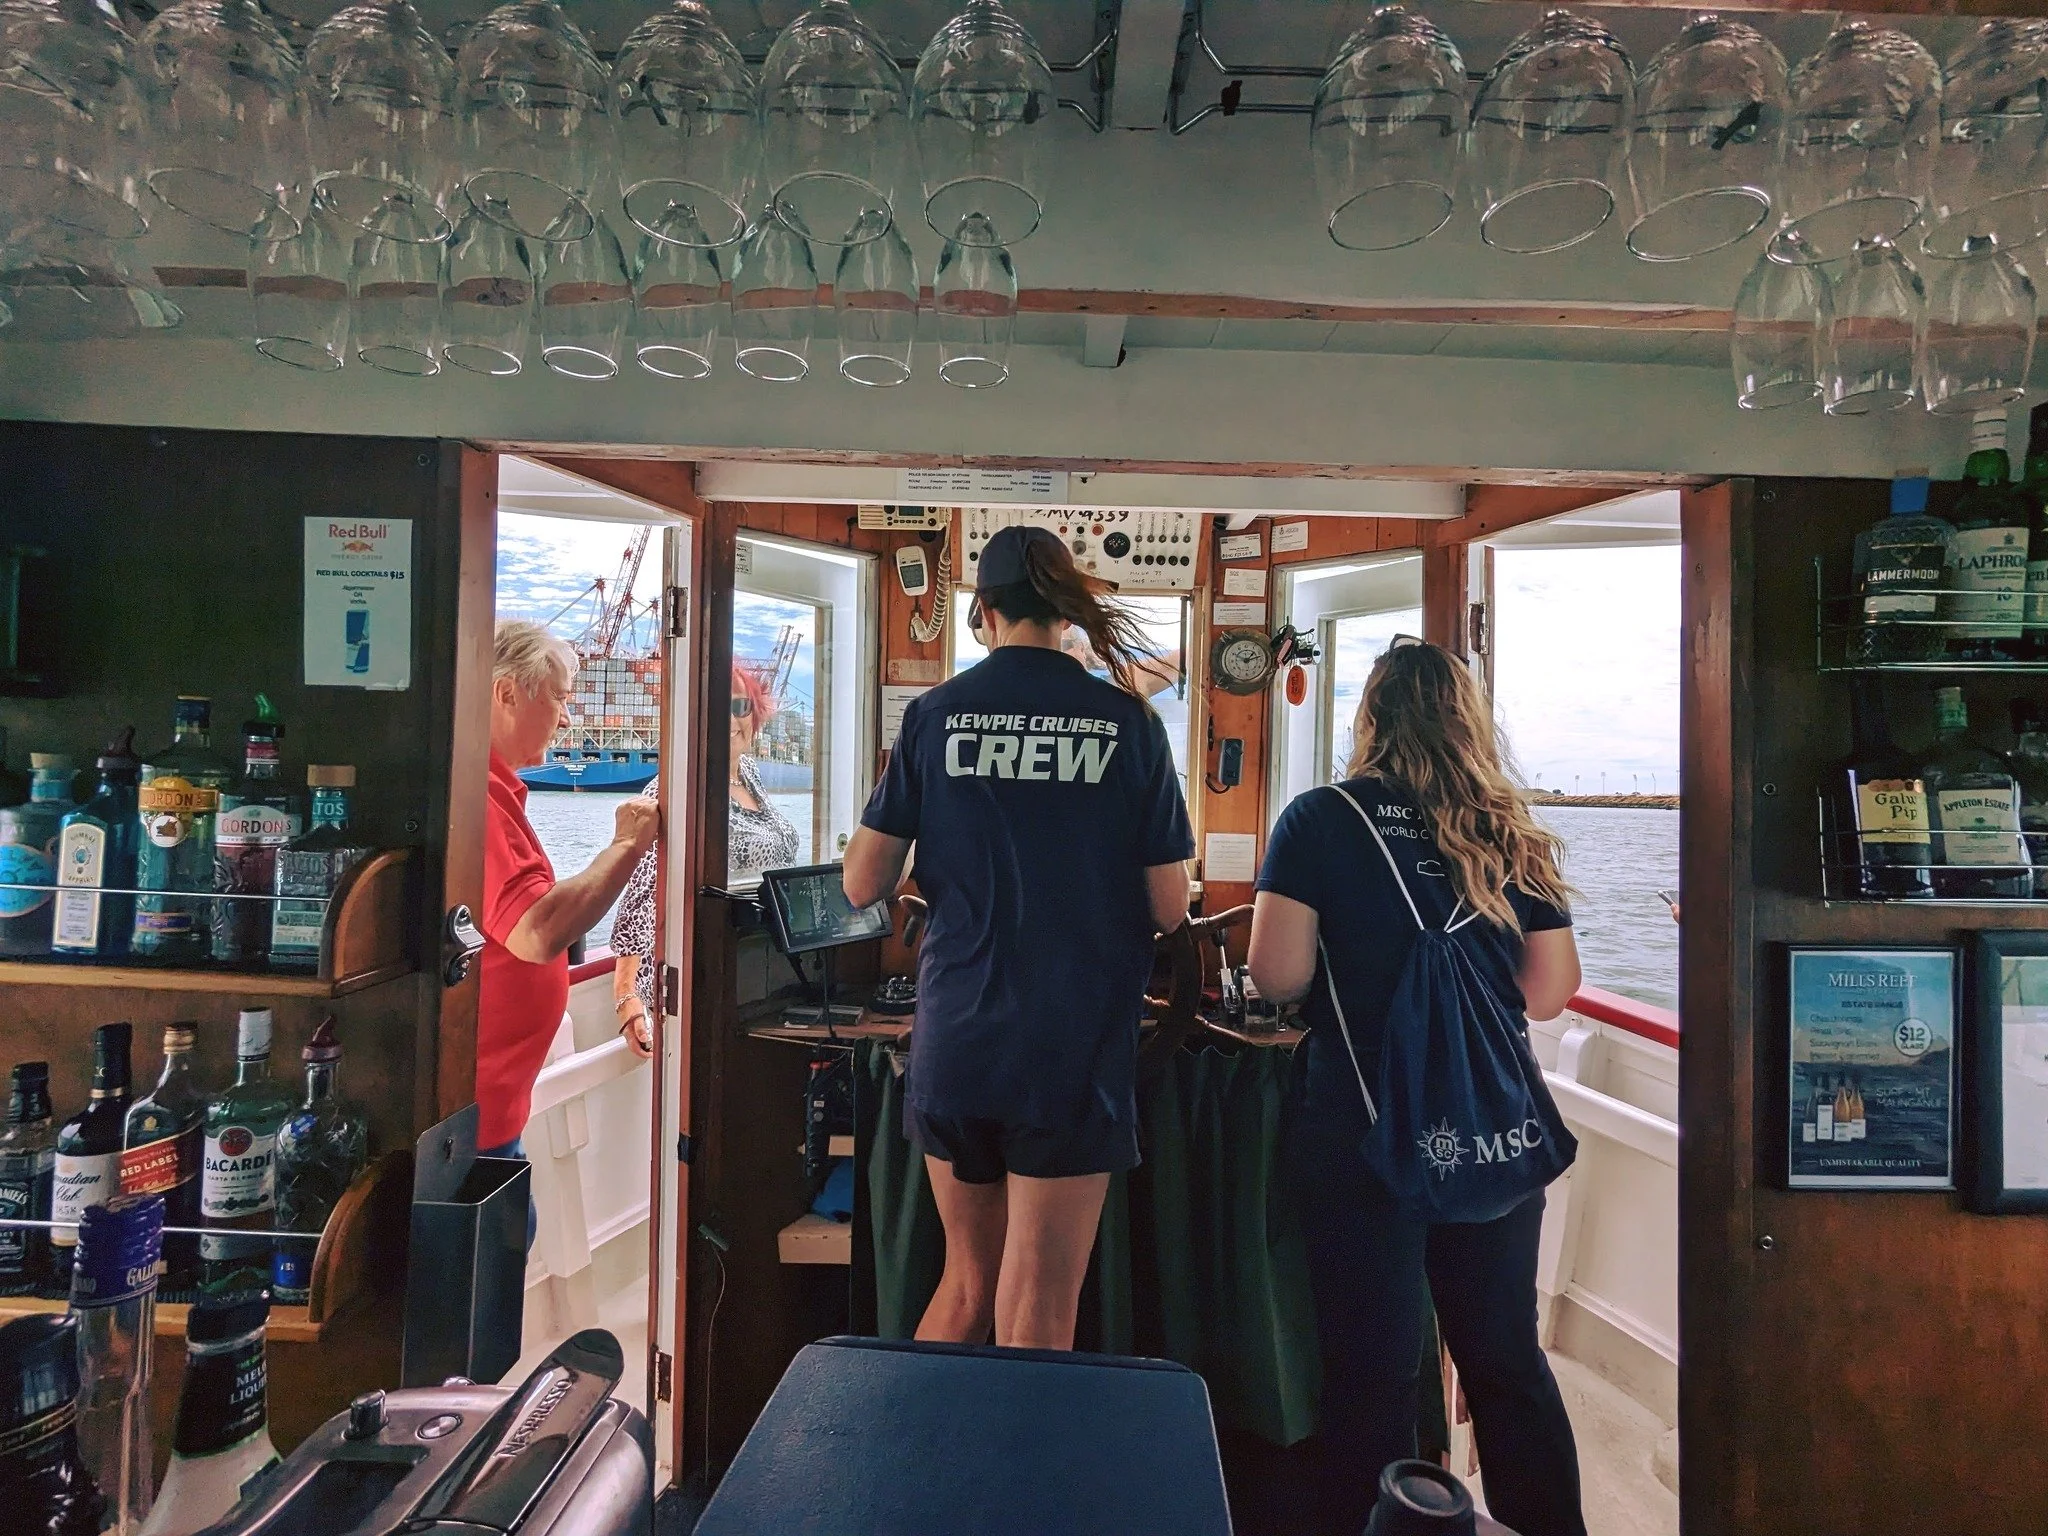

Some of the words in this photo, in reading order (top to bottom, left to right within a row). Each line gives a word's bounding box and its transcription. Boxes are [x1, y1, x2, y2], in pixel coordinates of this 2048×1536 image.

[328, 523, 357, 538] Red
[359, 524, 387, 539] Bull
[351, 570, 389, 578] COCKTAILS
[1867, 569, 1940, 582] LAMMERMOOR
[945, 713, 1026, 731] KEWPIE
[1029, 715, 1119, 737] CRUISES
[945, 733, 1118, 784] CREW
[1376, 804, 1413, 820] MSC
[1943, 798, 1982, 813] APPLETON
[1984, 798, 2011, 812] ESTATE
[1378, 825, 1418, 839] WORLD
[1828, 972, 1875, 988] MILLS
[1878, 973, 1918, 988] REEF
[1898, 1025, 1926, 1043] $12
[1472, 1118, 1543, 1164] MSC
[120, 1165, 142, 1178] RED
[144, 1153, 179, 1170] LABEL
[206, 1149, 272, 1173] BACARDÍ
[1819, 1159, 1883, 1167] UNMISTAKABLE
[1884, 1159, 1922, 1168] QUALITY
[493, 1379, 573, 1458] NESPRESSO
